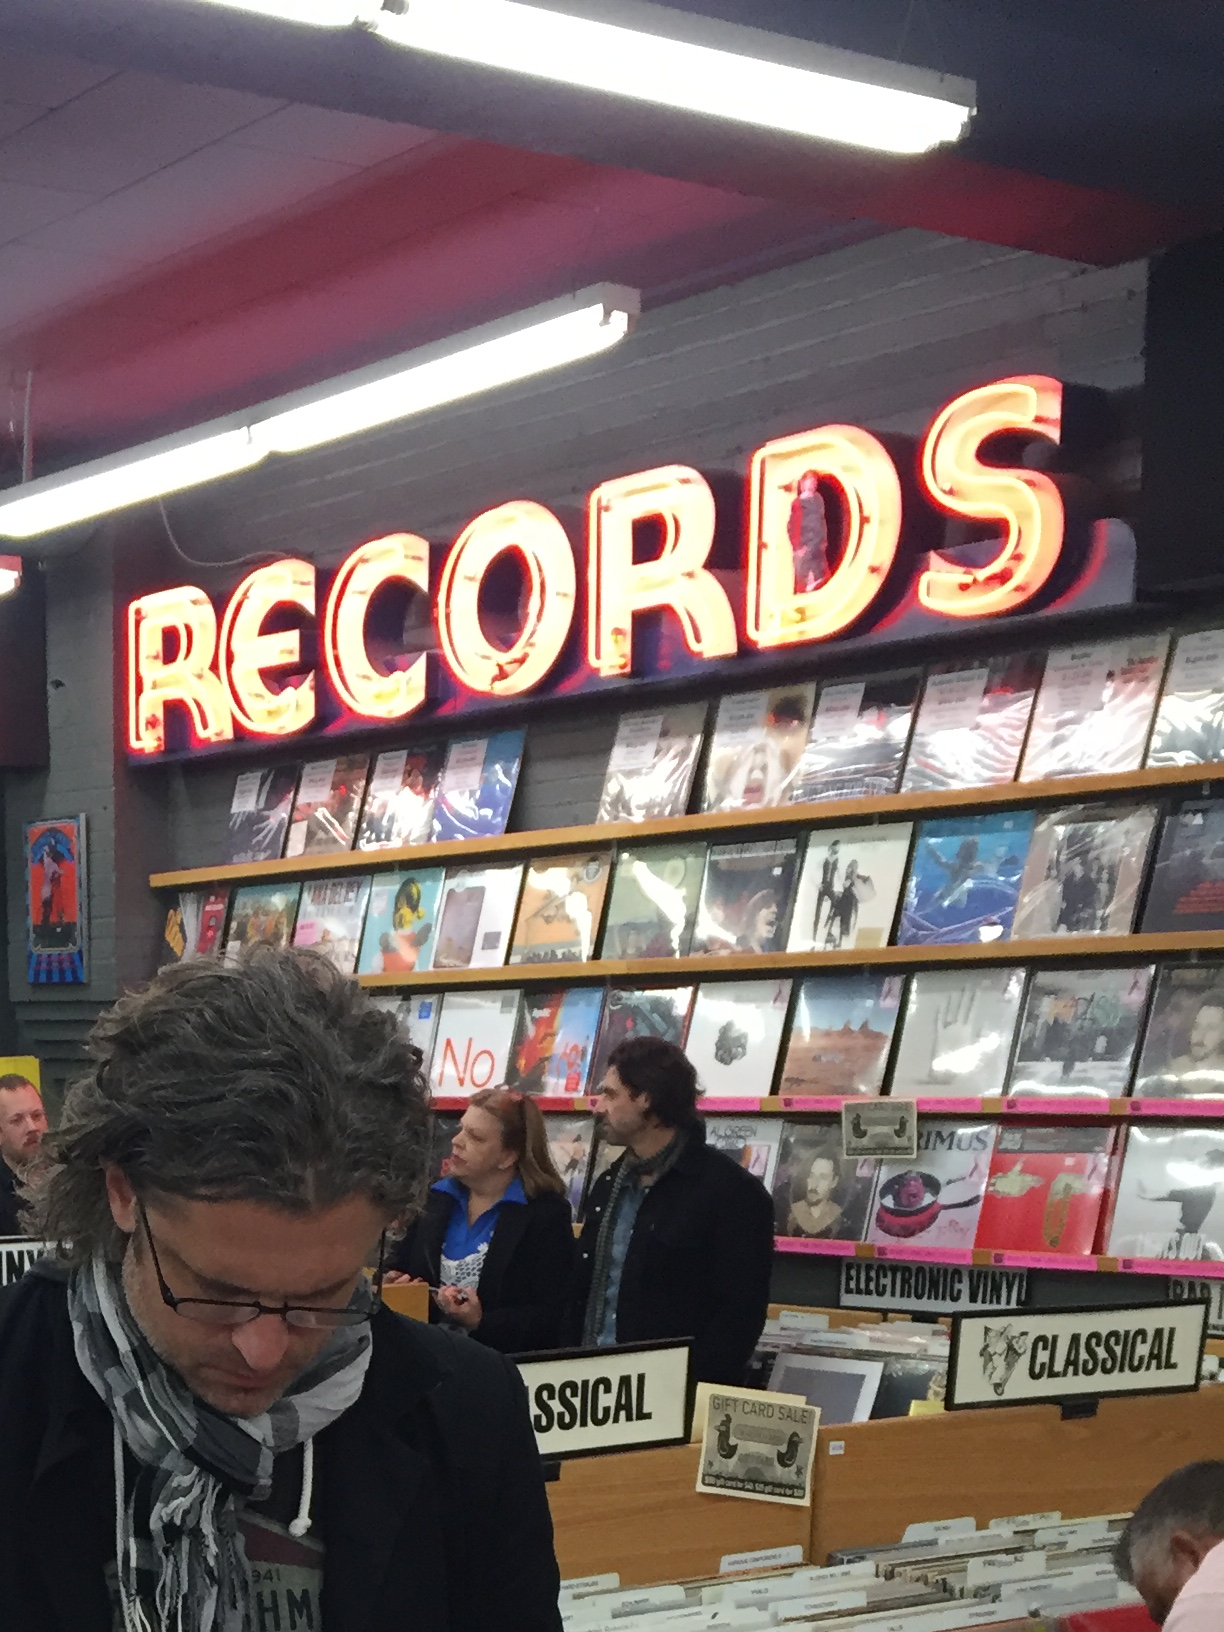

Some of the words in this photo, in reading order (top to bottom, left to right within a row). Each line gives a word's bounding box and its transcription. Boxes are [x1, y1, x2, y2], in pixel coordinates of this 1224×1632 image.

[127, 374, 1064, 754] RECORDS
[437, 1036, 495, 1089] No
[844, 1261, 964, 1303] ELECTRONIC
[1028, 1327, 1178, 1381] CLASSICAL
[712, 1397, 738, 1413] GIFT
[742, 1401, 775, 1419] CARD
